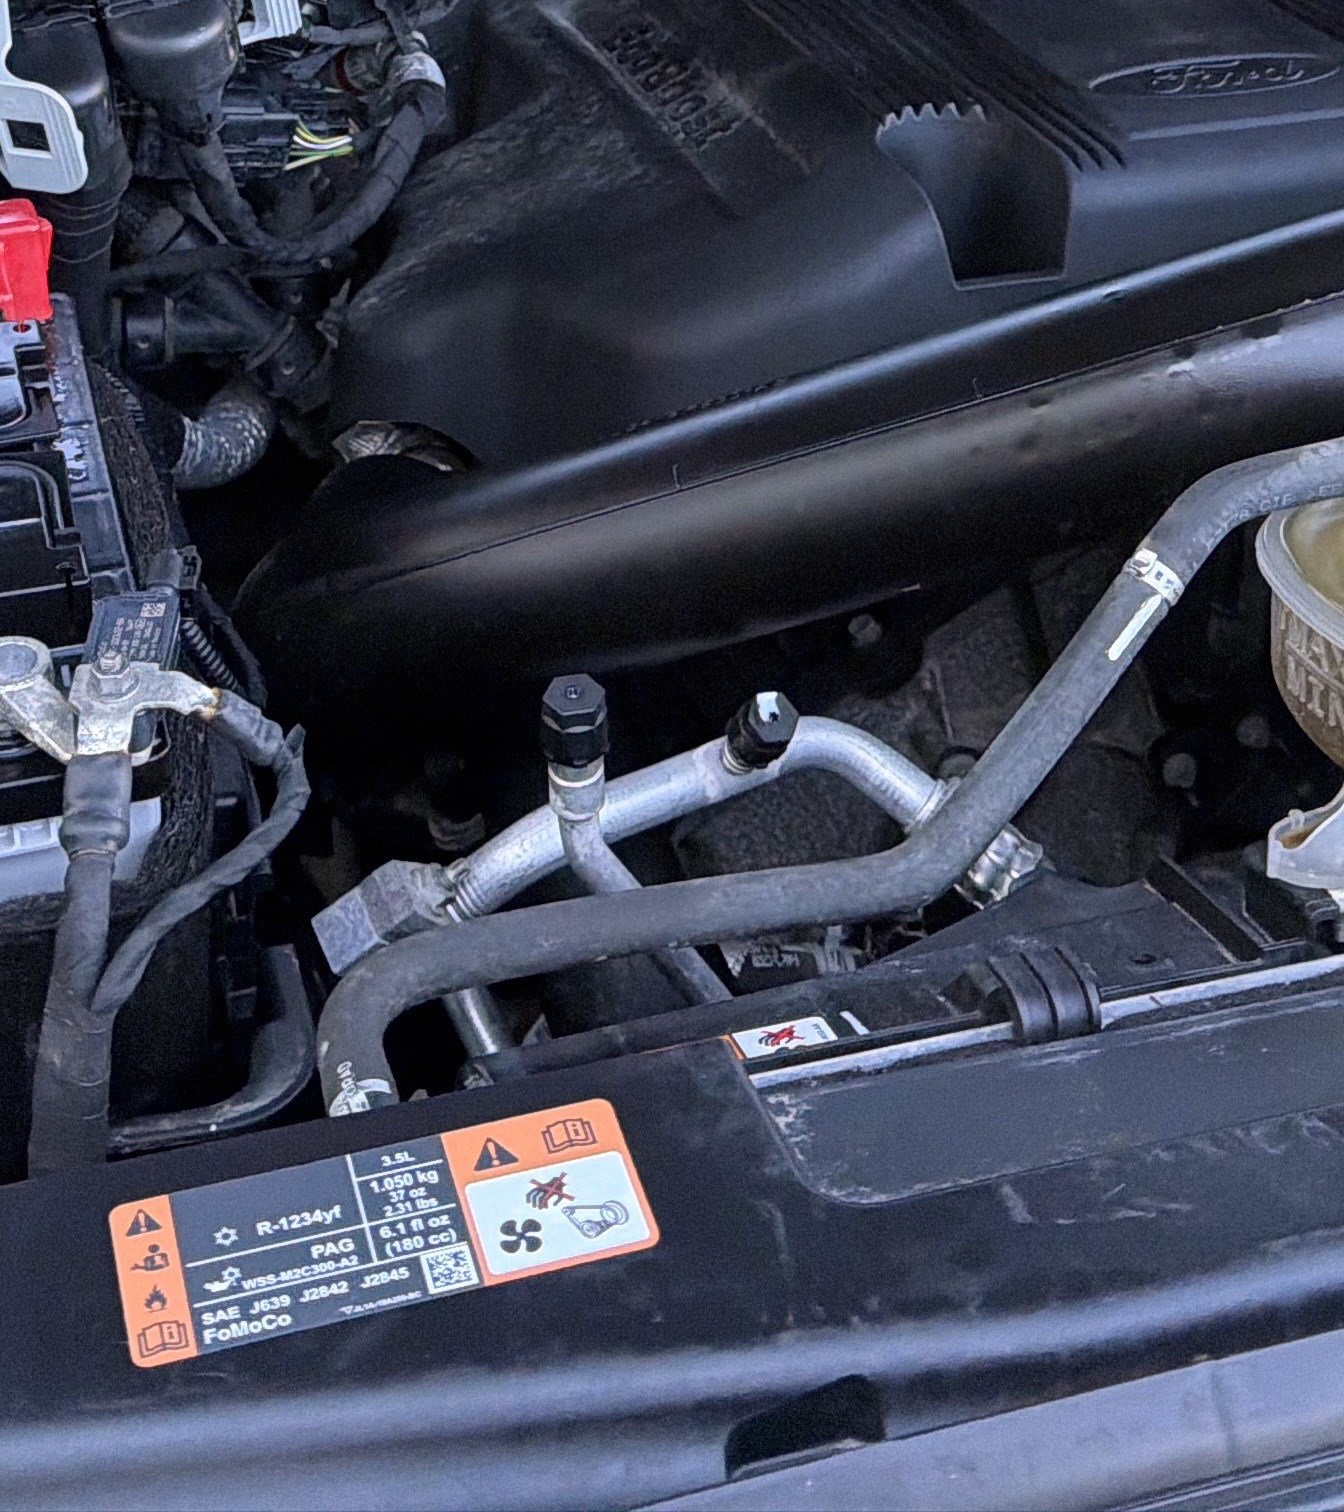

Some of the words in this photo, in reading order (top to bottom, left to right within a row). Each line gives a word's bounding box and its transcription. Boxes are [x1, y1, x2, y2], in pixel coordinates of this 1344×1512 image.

[1149, 59, 1306, 96] Ford
[380, 1151, 416, 1167] 3.5L
[369, 1172, 414, 1193] 1.050
[415, 1170, 440, 1184] kg
[388, 1189, 406, 1203] 37
[408, 1187, 428, 1199] oz
[256, 1205, 343, 1236] R-1234yf
[383, 1200, 413, 1217] 2.31
[415, 1197, 439, 1210] lbs
[378, 1222, 407, 1239] 6.1
[410, 1217, 425, 1232] fl
[427, 1214, 451, 1228] oz
[311, 1238, 356, 1259] PAG
[385, 1235, 425, 1258] (180
[427, 1227, 457, 1245] cc)
[242, 1255, 360, 1290] WSS-M2C300-A2
[201, 1306, 242, 1327] SAE
[249, 1294, 292, 1315] J639
[298, 1280, 350, 1303] J2842
[360, 1266, 410, 1289] J2845
[202, 1314, 293, 1345] FoMoCo
